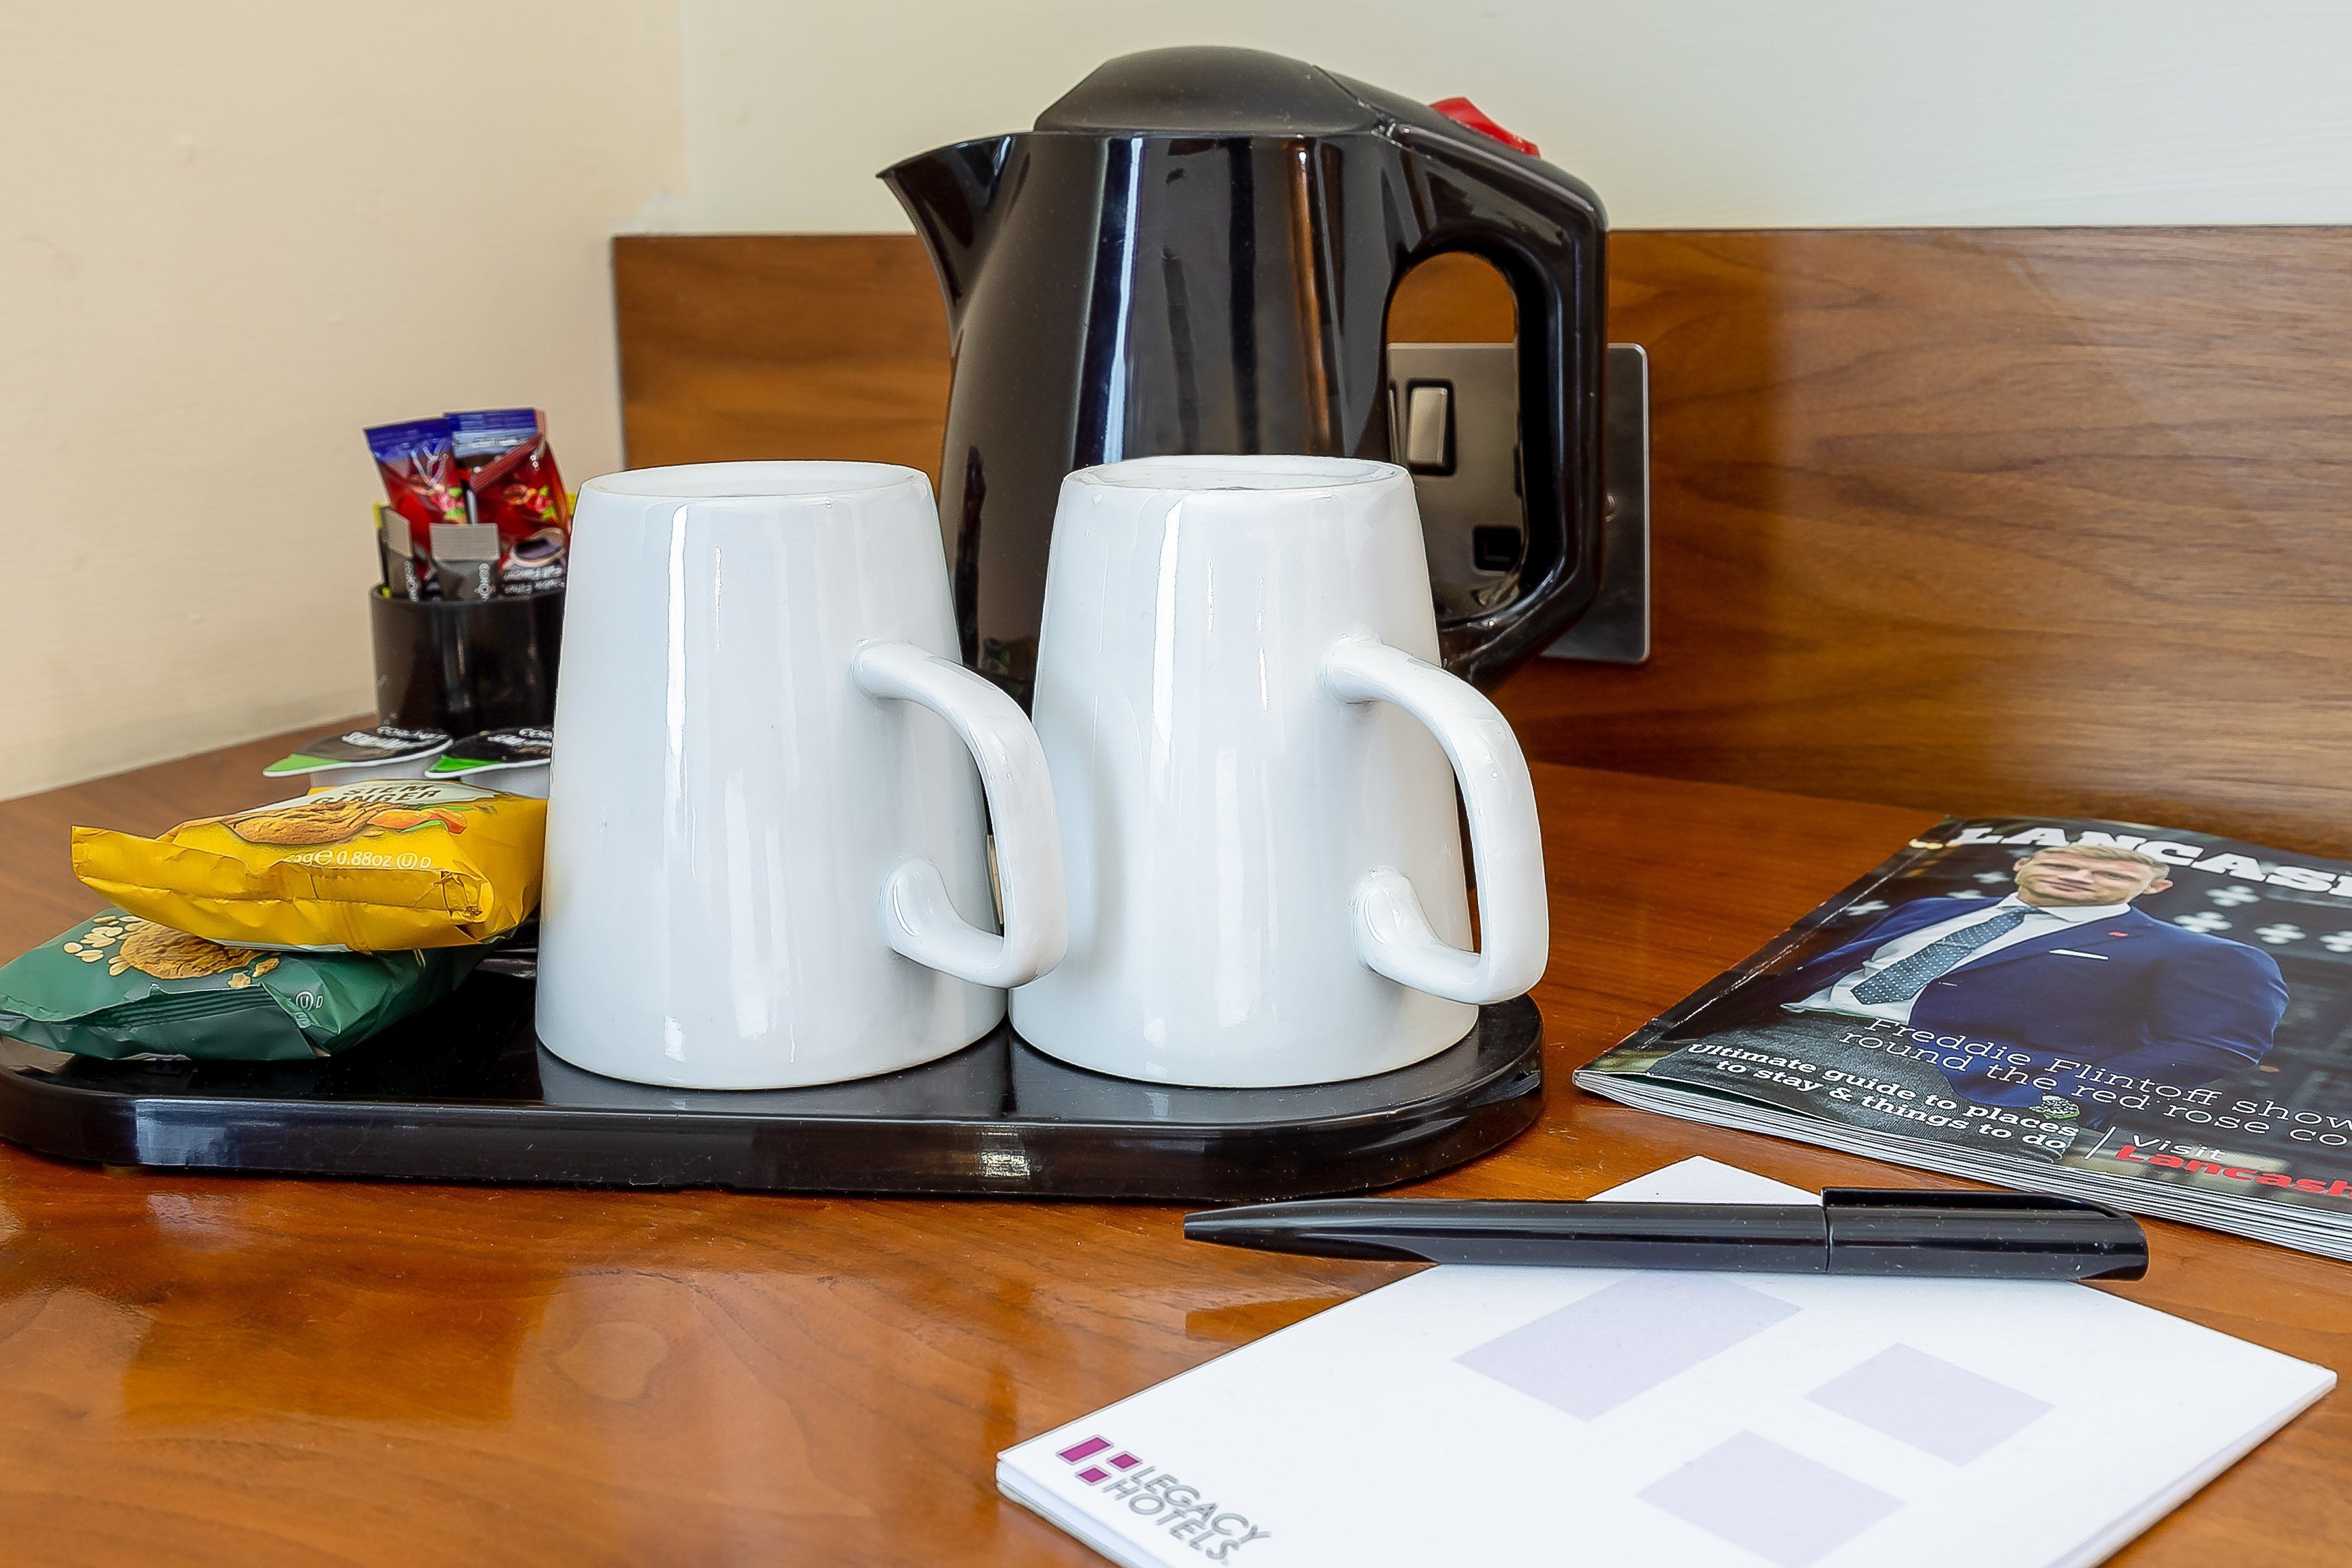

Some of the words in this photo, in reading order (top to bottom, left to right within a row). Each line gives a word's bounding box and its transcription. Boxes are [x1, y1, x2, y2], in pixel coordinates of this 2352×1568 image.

[309, 790, 442, 804] GINGER
[342, 784, 434, 796] STEM
[336, 850, 393, 867] 0.88oz
[1687, 1044, 1817, 1073] Ultimate
[1821, 1069, 1917, 1101] guide
[1925, 1093, 1957, 1110] to
[1961, 1104, 2080, 1137] places
[1838, 1032, 1974, 1072] round
[1985, 1063, 2058, 1090] the
[2071, 1084, 2152, 1111] red
[2163, 1104, 2270, 1134] rose
[2289, 1128, 2348, 1146] co
[1864, 1017, 2032, 1066] Freddie
[2044, 1057, 2223, 1106] Flintoff
[1715, 1060, 1747, 1074] to
[1753, 1069, 1824, 1092] stay
[1828, 1086, 1854, 1102] &
[1860, 1095, 1970, 1130] things
[1978, 1122, 2013, 1139] to
[2021, 1133, 2067, 1150] do
[2132, 1134, 2227, 1162] Visit
[1102, 1478, 1240, 1561] HOTELS
[1130, 1465, 1272, 1545] LEGACY
